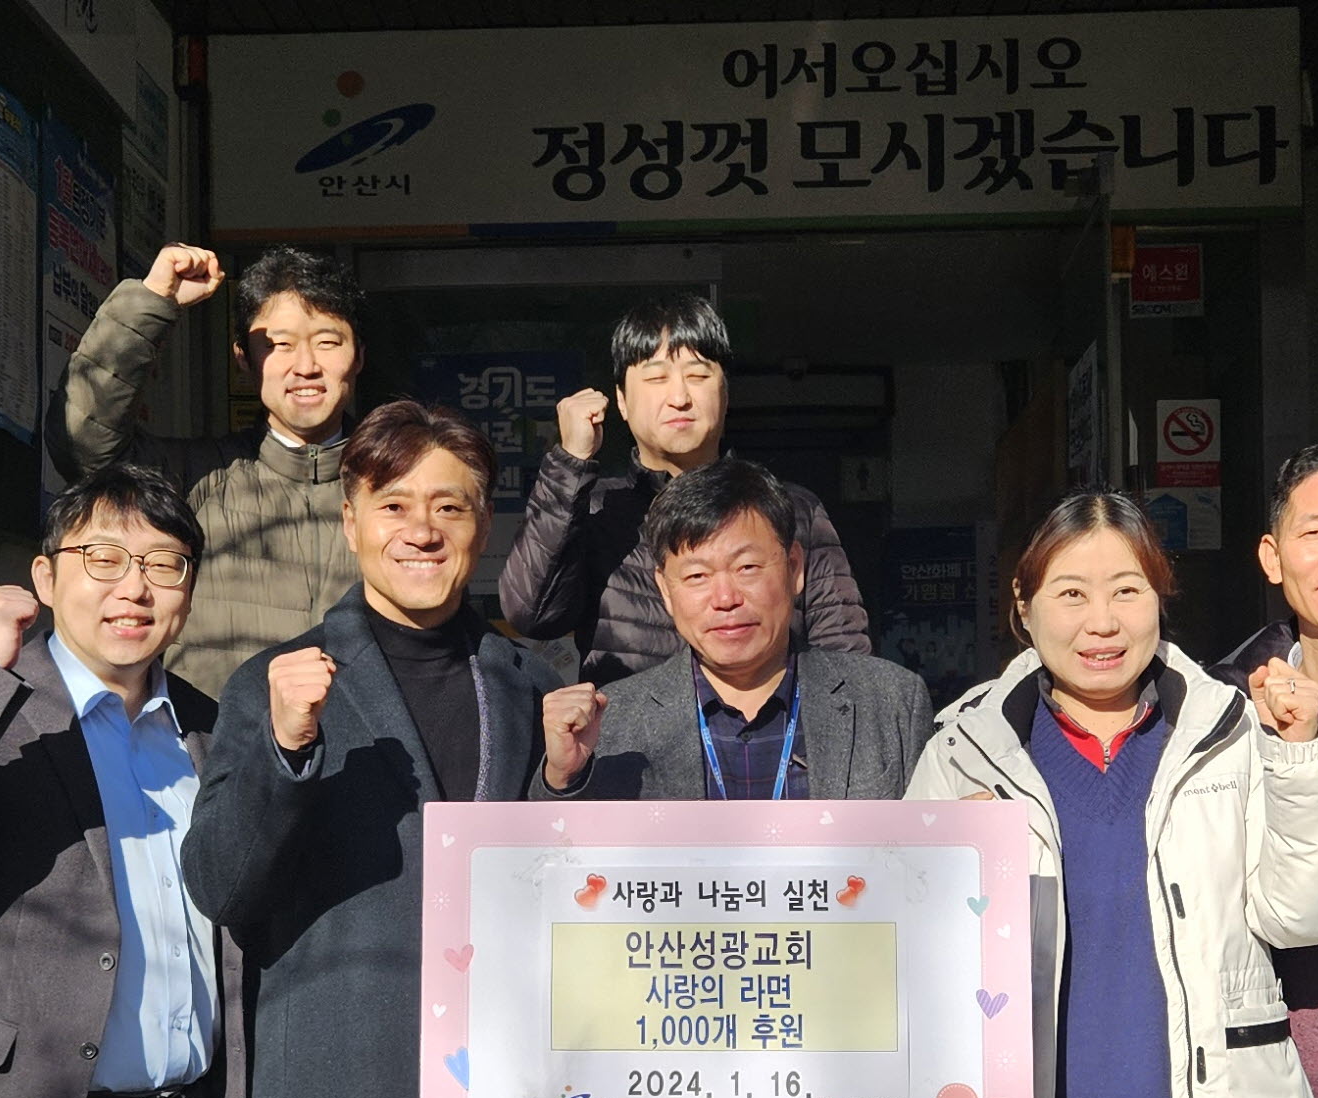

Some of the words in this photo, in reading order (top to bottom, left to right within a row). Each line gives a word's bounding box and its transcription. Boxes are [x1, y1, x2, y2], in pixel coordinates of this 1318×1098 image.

[721, 36, 1088, 98] 어서오십시오
[533, 120, 771, 201] 정성껏
[792, 106, 1288, 194] 모시겠습니다
[317, 174, 412, 198] 안산시
[1143, 264, 1188, 281] 에스원
[458, 366, 555, 409] 경기도
[612, 879, 683, 910] 사랑과
[698, 879, 767, 910] 나눔의
[784, 879, 831, 911] 실천
[625, 930, 815, 971] 안산성광교회
[646, 974, 727, 1010] 사랑의
[740, 973, 792, 1010] 라면
[636, 1014, 738, 1051] 1,000개
[751, 1014, 804, 1049] 후원
[628, 1071, 713, 1098] 2024.
[731, 1072, 753, 1098] 1.
[771, 1071, 812, 1098] 16.
